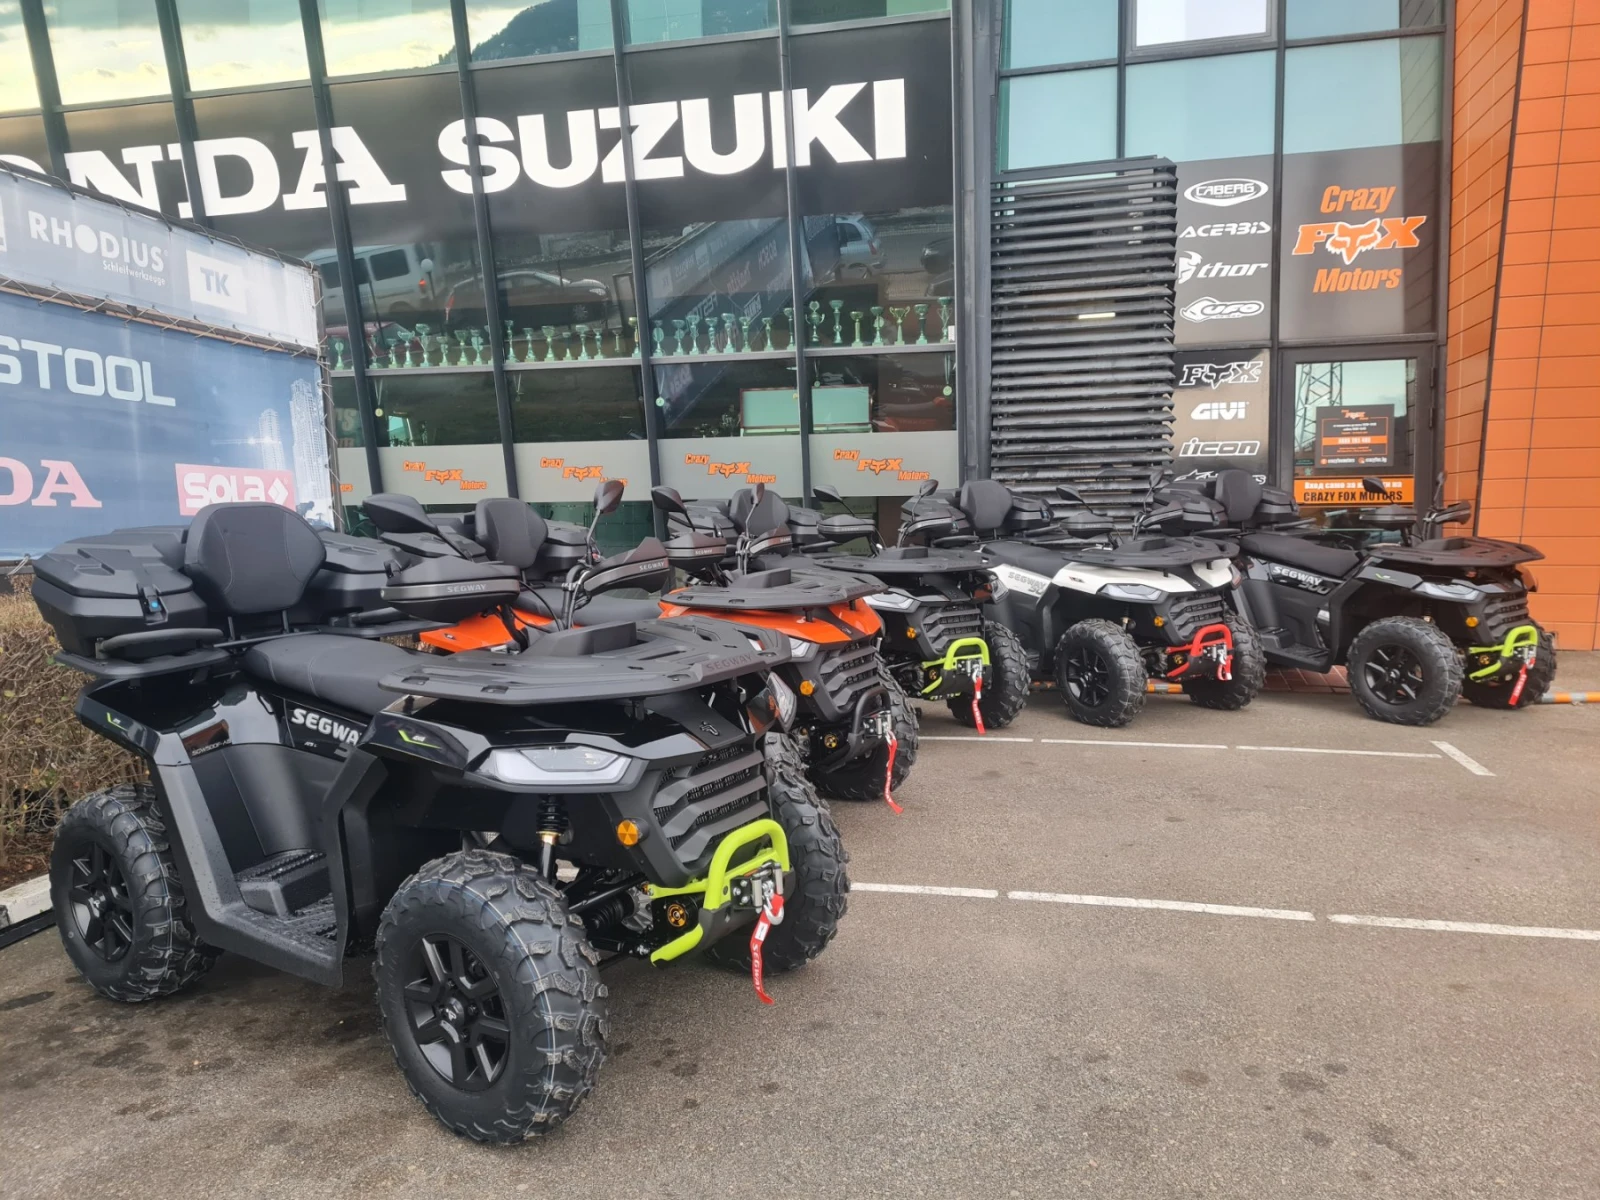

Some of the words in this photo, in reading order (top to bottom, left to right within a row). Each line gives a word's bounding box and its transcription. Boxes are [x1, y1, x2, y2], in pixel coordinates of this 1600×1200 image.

[0, 126, 407, 219] NDA
[438, 78, 907, 194] SUZUKI
[1196, 183, 1255, 196] CABERG
[1320, 185, 1397, 214] Crazy
[1179, 221, 1271, 238] ACERBIS
[28, 209, 165, 273] RHODIUS
[1292, 215, 1427, 265] FOX
[102, 260, 166, 286] Schleifwerkzeuge
[1197, 262, 1269, 278] thor
[200, 268, 230, 297] TK
[1312, 268, 1403, 293] Motors
[1201, 304, 1261, 316] UFO
[1179, 361, 1263, 389] FOX
[1190, 402, 1246, 420] GIVI
[685, 453, 710, 465] Crazy
[834, 448, 860, 461] Crazy
[562, 466, 603, 482] FOX
[707, 462, 751, 479] FOX
[857, 458, 903, 475] FOX
[424, 469, 463, 485] FOX
[746, 474, 776, 484] Motors
[898, 471, 930, 481] Motors
[1304, 491, 1333, 502] CRAZY
[1338, 491, 1357, 501] FOX
[639, 561, 665, 571] SEGWAY
[1008, 571, 1047, 589] SEGWAY
[1272, 566, 1322, 586] SEGWAY
[447, 583, 487, 593] SEGWAY
[705, 653, 752, 672] SEGWAY
[291, 708, 362, 745] SEGWA
